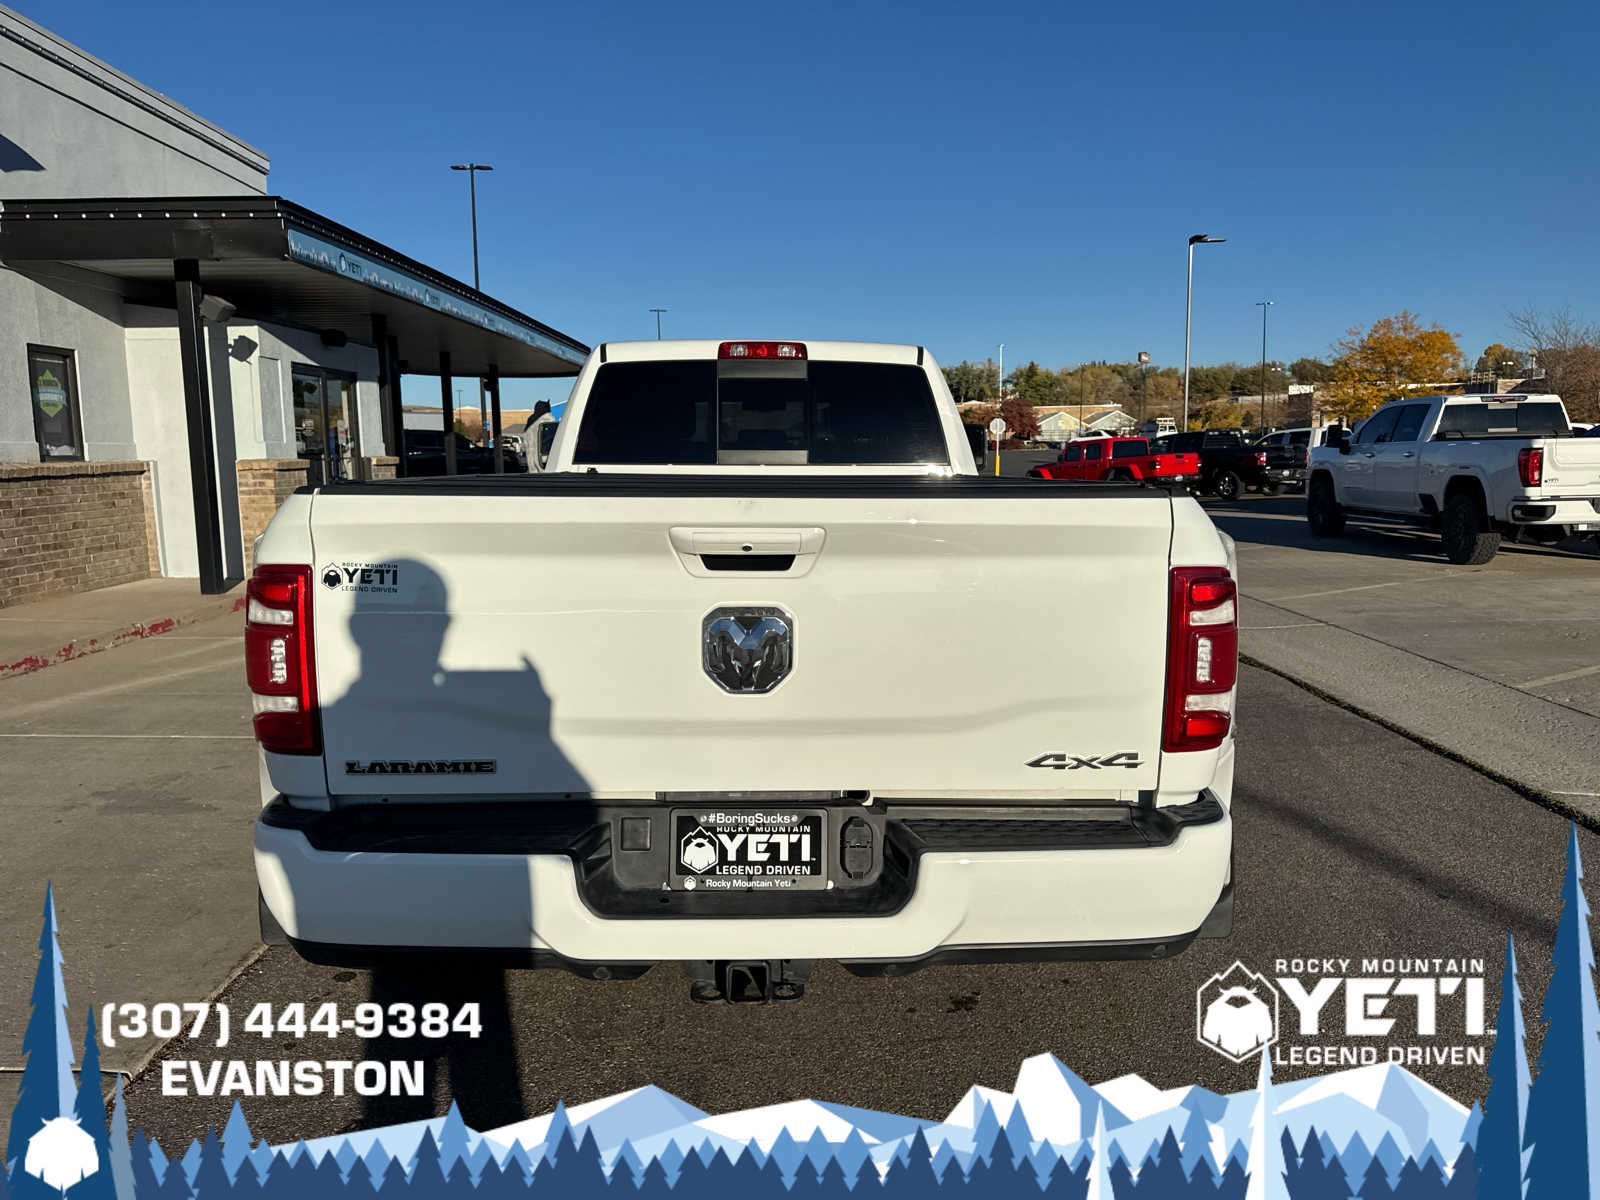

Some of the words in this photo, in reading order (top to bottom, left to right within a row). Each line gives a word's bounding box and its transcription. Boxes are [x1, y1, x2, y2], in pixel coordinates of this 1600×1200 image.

[343, 568, 398, 585] YETI
[345, 760, 497, 775] LARAMIE
[1024, 752, 1146, 770] 4x4
[708, 813, 791, 826] #BoringSucks
[716, 833, 811, 862] YETI
[716, 865, 762, 875] LEGEND
[766, 865, 811, 875] DRIVEN
[706, 879, 731, 890] Rocky
[732, 879, 772, 889] Mountain
[774, 879, 791, 888] Yeti
